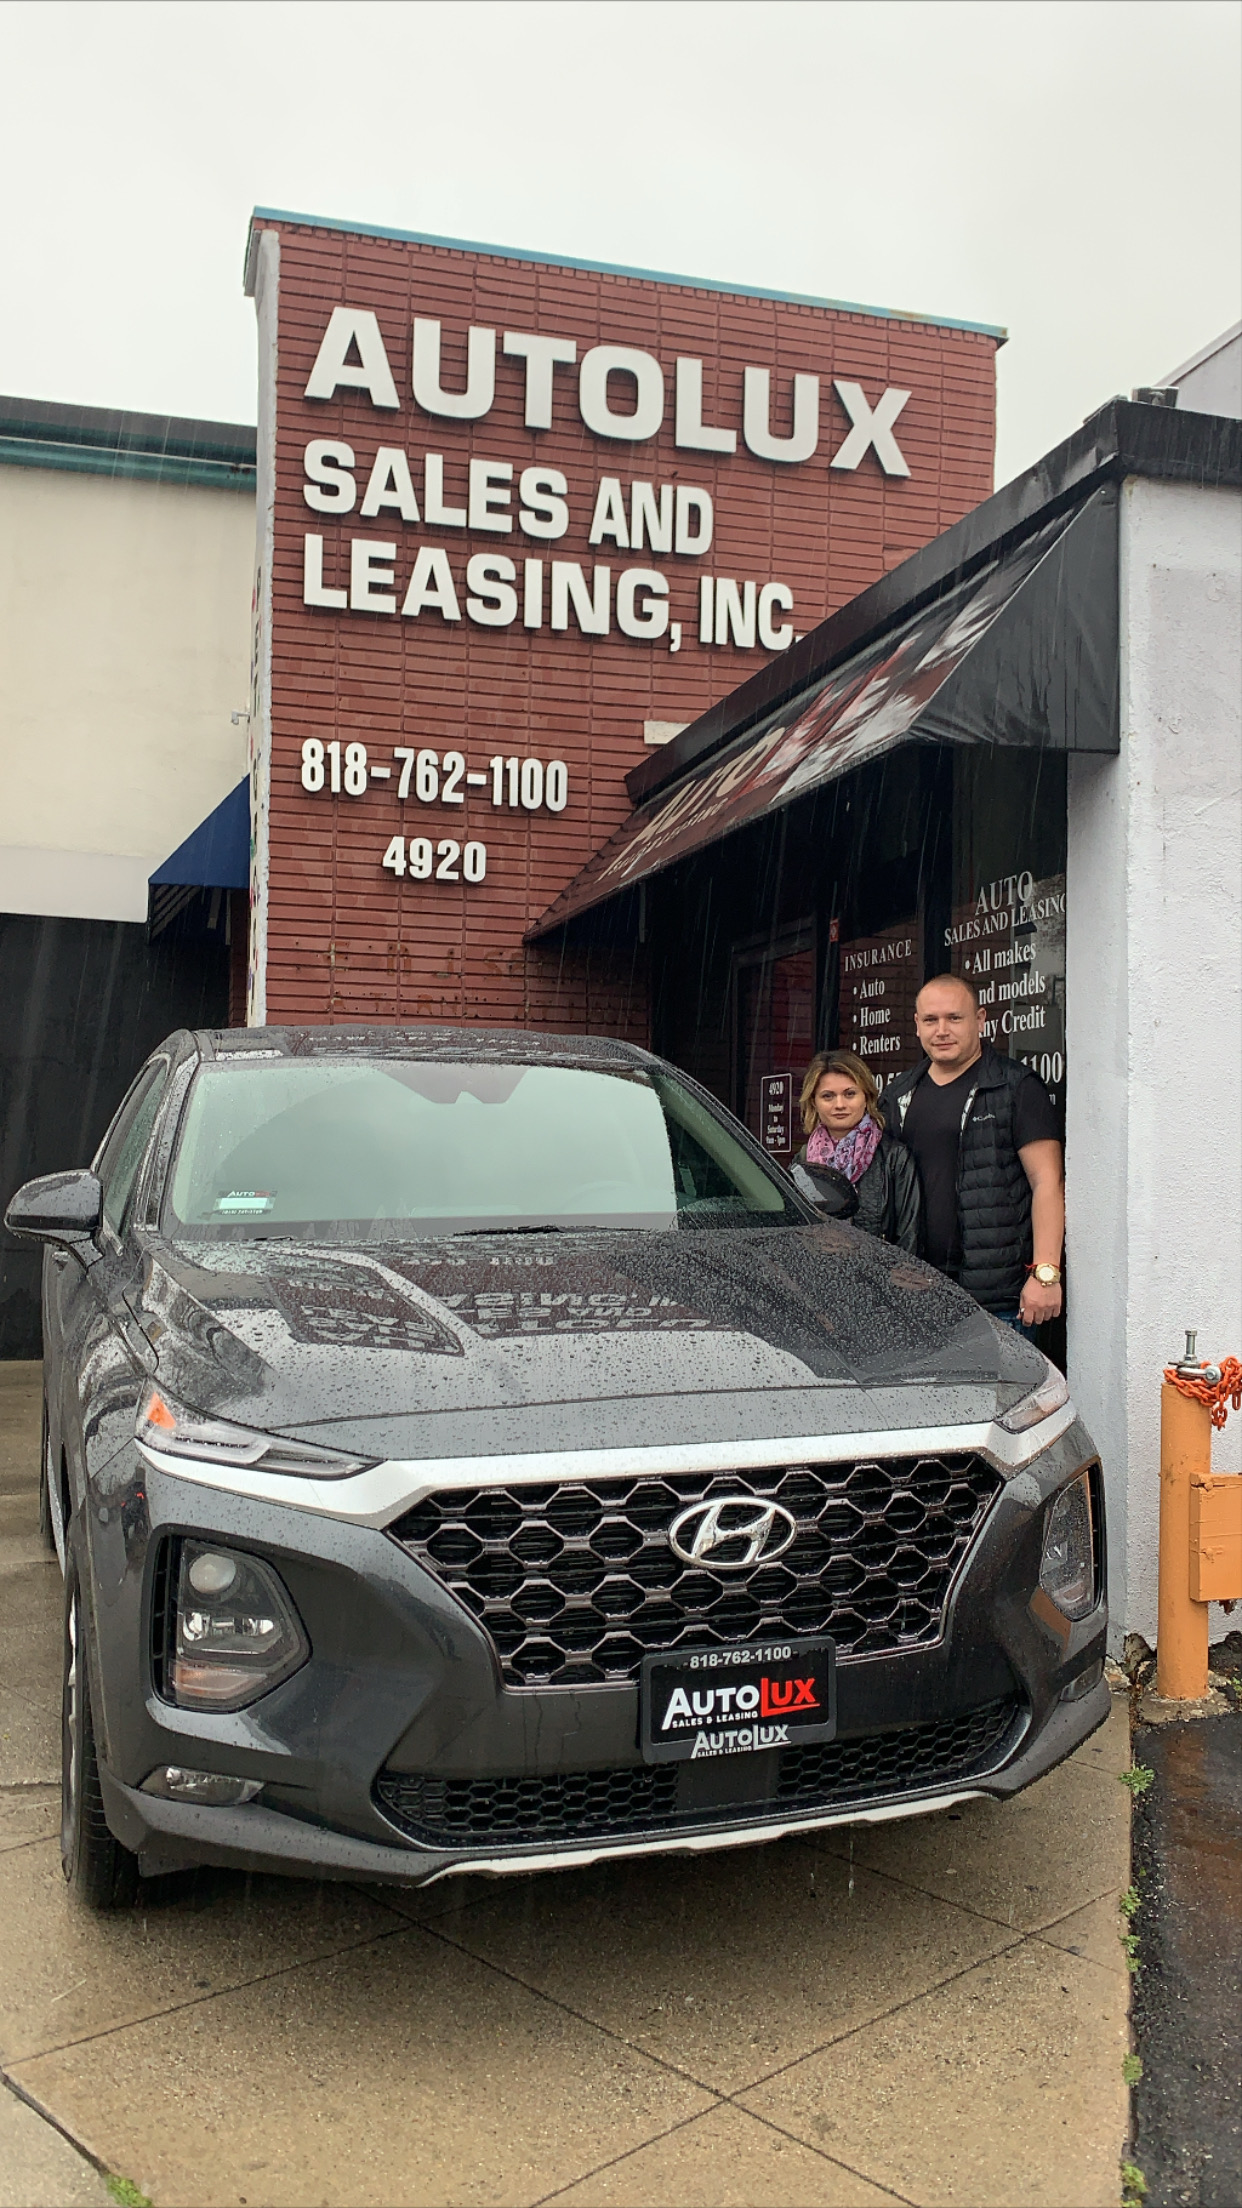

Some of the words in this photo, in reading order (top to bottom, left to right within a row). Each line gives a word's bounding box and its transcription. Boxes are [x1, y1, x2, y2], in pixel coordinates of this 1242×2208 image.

[303, 305, 913, 478] AUTOLUX
[303, 439, 569, 541] SALES
[588, 477, 714, 555] AND
[303, 532, 682, 652] LEASING,
[700, 575, 804, 651] INC
[301, 738, 568, 812] 818-762-1100
[382, 836, 487, 883] 4920
[975, 871, 1033, 917] AUTO
[944, 919, 981, 947] SALES
[981, 911, 1009, 936] AND
[844, 939, 912, 972] INSURANCE
[972, 948, 991, 974] All
[994, 941, 1037, 969] makes
[859, 978, 885, 999] Auto
[979, 980, 995, 1005] nd
[998, 970, 1046, 1001] models
[859, 1006, 891, 1028] Home
[979, 1018, 998, 1043] ny
[1001, 1004, 1046, 1033] Credit
[859, 1034, 901, 1056] Renters
[672, 1717, 703, 1729] SALES
[716, 1710, 758, 1723] LEASING
